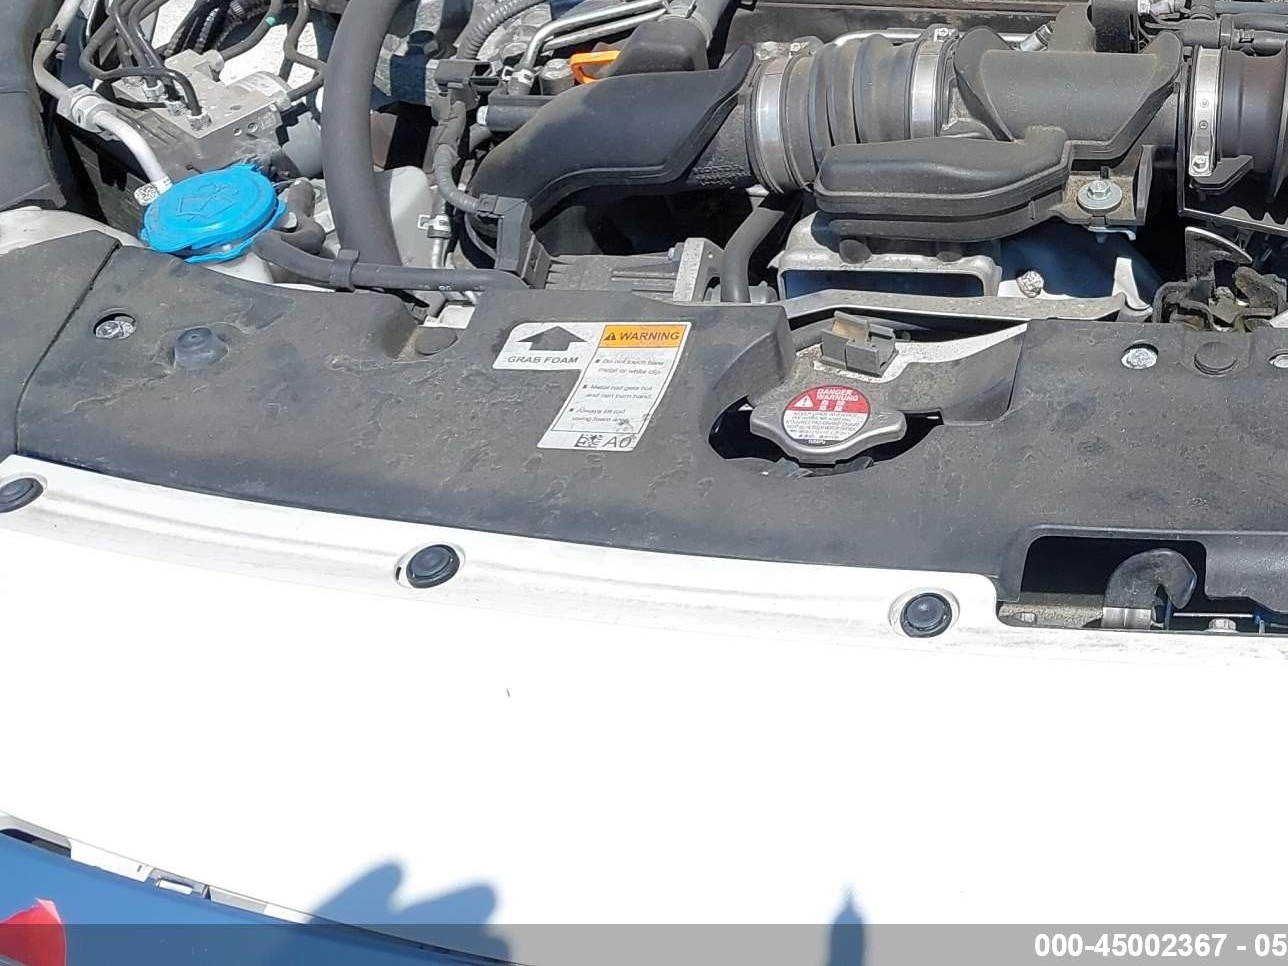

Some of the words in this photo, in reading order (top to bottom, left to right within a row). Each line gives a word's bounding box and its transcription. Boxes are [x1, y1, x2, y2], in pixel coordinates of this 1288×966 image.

[619, 331, 680, 341] WARNING
[507, 355, 541, 364] GRAB
[543, 356, 578, 364] FOAM
